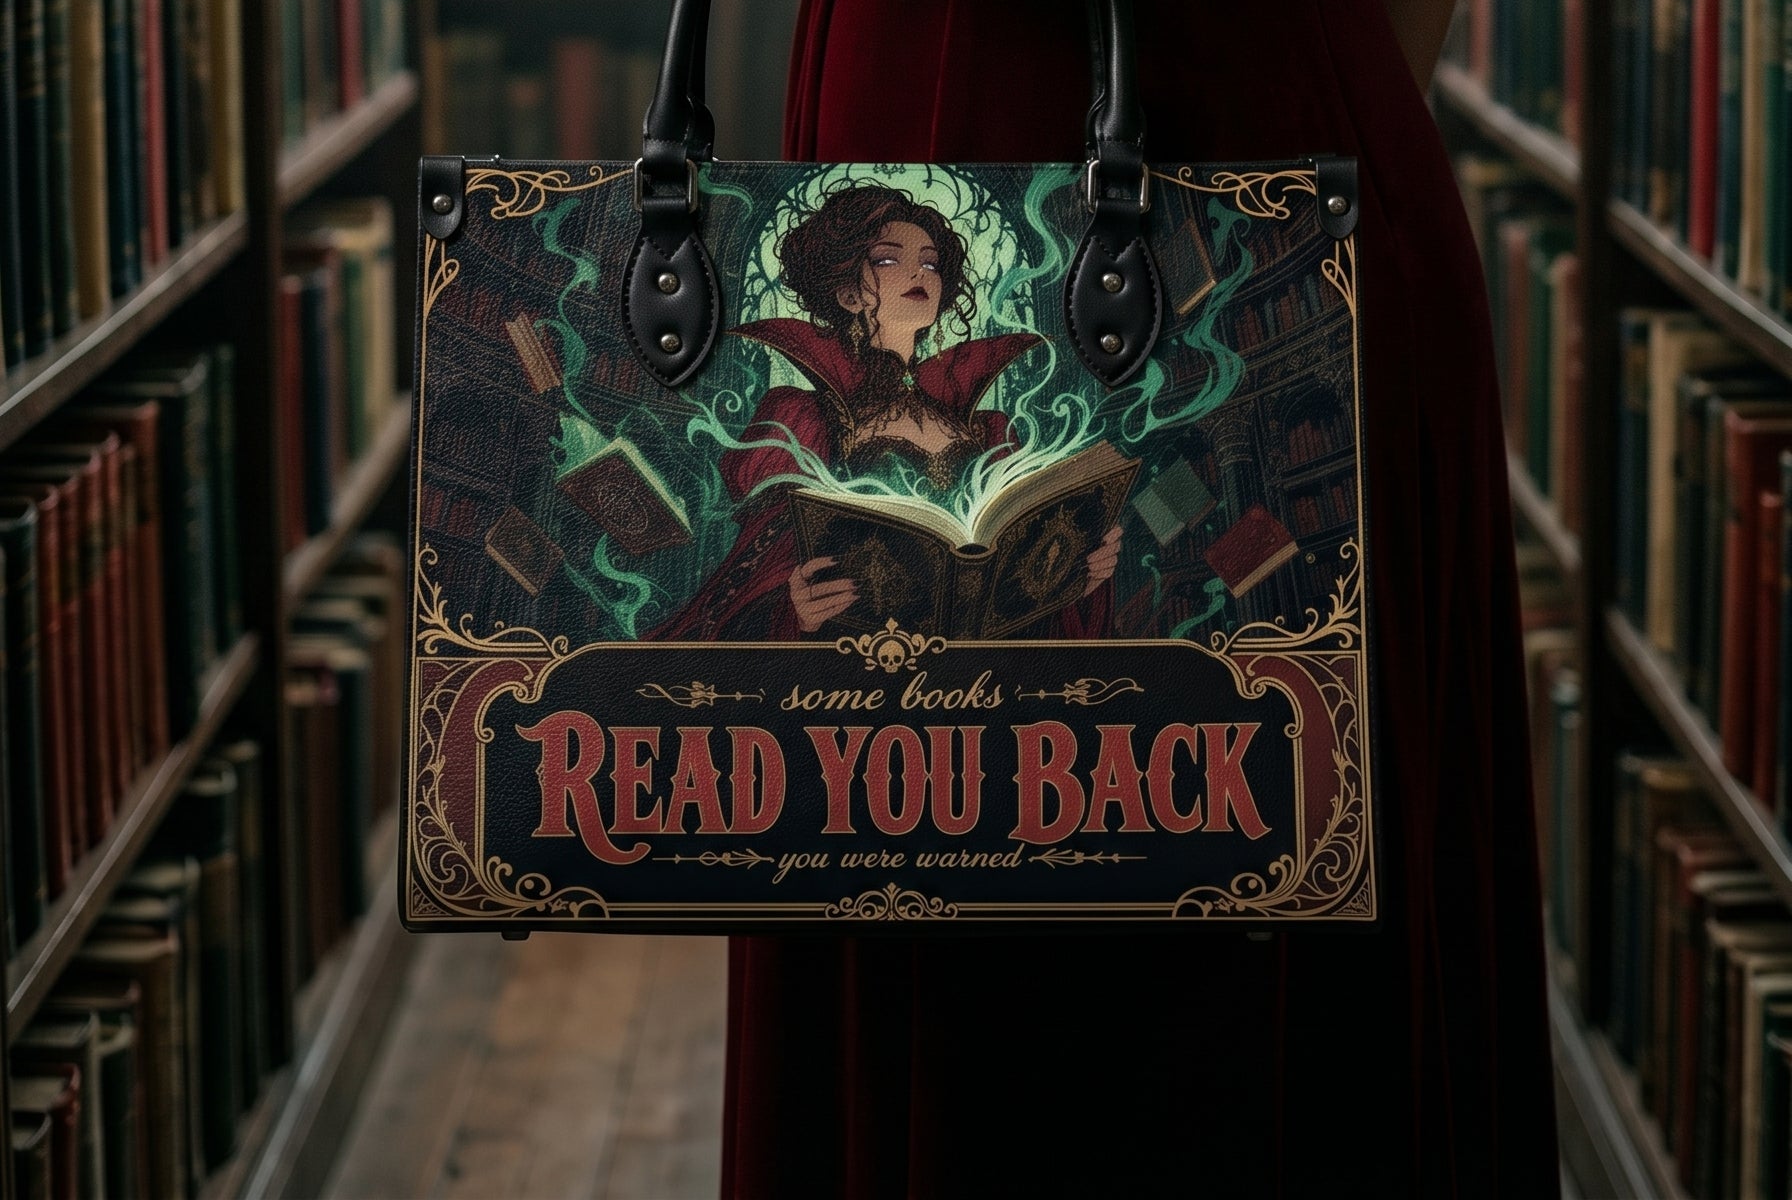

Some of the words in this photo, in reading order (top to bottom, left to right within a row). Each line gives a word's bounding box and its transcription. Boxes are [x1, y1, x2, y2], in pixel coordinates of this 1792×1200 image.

[780, 684, 885, 711] some
[901, 670, 1004, 711] books
[515, 710, 787, 865] READ
[804, 724, 986, 836] YOU
[1009, 719, 1272, 846] BACK
[771, 852, 831, 885] you
[840, 851, 908, 869] were
[915, 842, 1025, 869] warned
